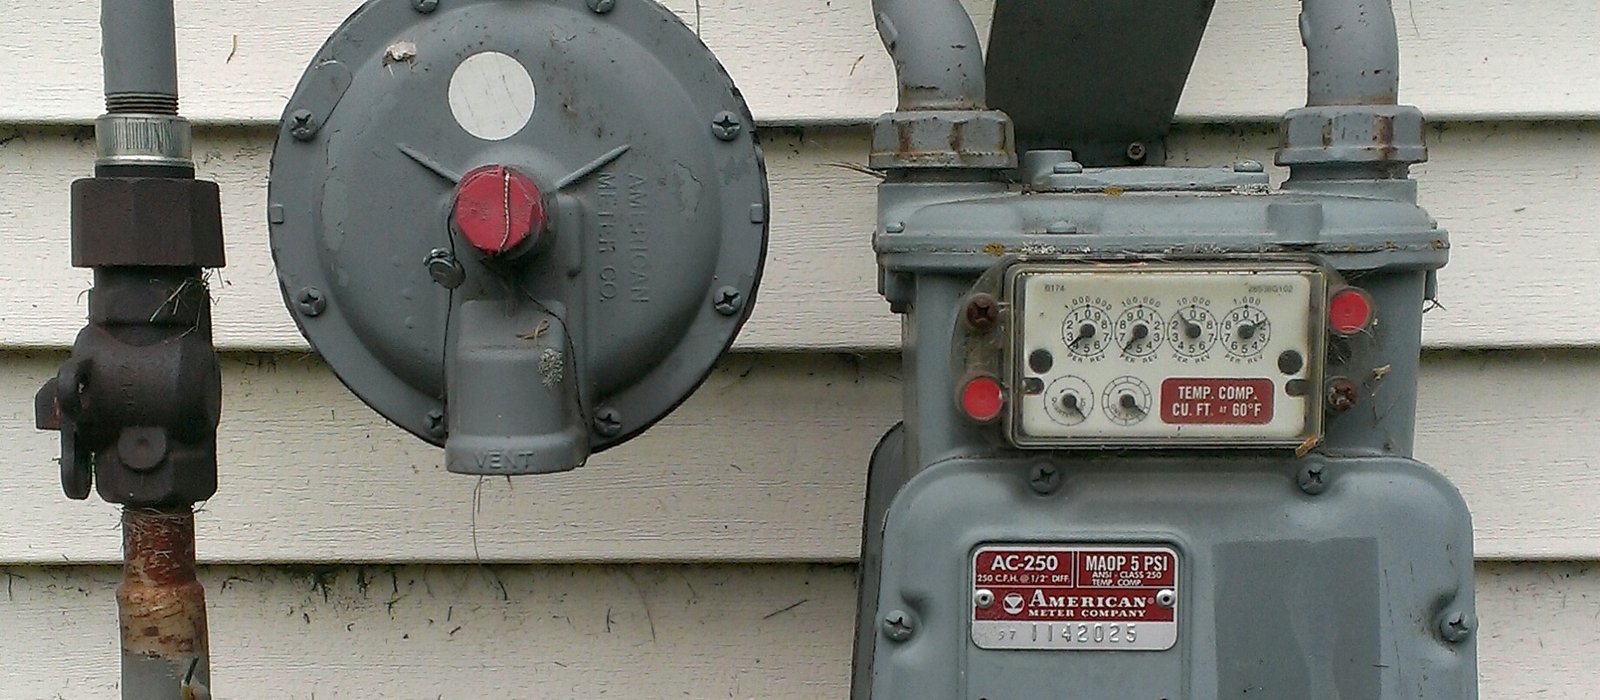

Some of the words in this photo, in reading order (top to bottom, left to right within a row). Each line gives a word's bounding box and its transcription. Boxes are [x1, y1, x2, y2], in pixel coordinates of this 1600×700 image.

[598, 172, 617, 253] METER
[628, 172, 648, 302] AMERICAN
[1233, 296, 1261, 306] 1,000
[1178, 386, 1214, 400] TEMP.
[1218, 386, 1258, 400] COMP.
[1172, 403, 1192, 416] CU.
[1232, 403, 1262, 417] 60°F
[474, 449, 534, 469] VENT
[991, 555, 1058, 571] AC-250
[1086, 556, 1126, 572] MAOP
[1131, 556, 1139, 572] 5
[1144, 556, 1168, 572] PSI
[977, 574, 992, 583] 250
[1052, 574, 1070, 583] DIFF.
[1092, 578, 1114, 586] TEMP.
[1146, 572, 1162, 580] 250
[1028, 589, 1146, 608] AMERICAN
[1028, 610, 1075, 618] METER
[1081, 610, 1146, 618] COMPANY
[1031, 622, 1138, 643] 1142025
